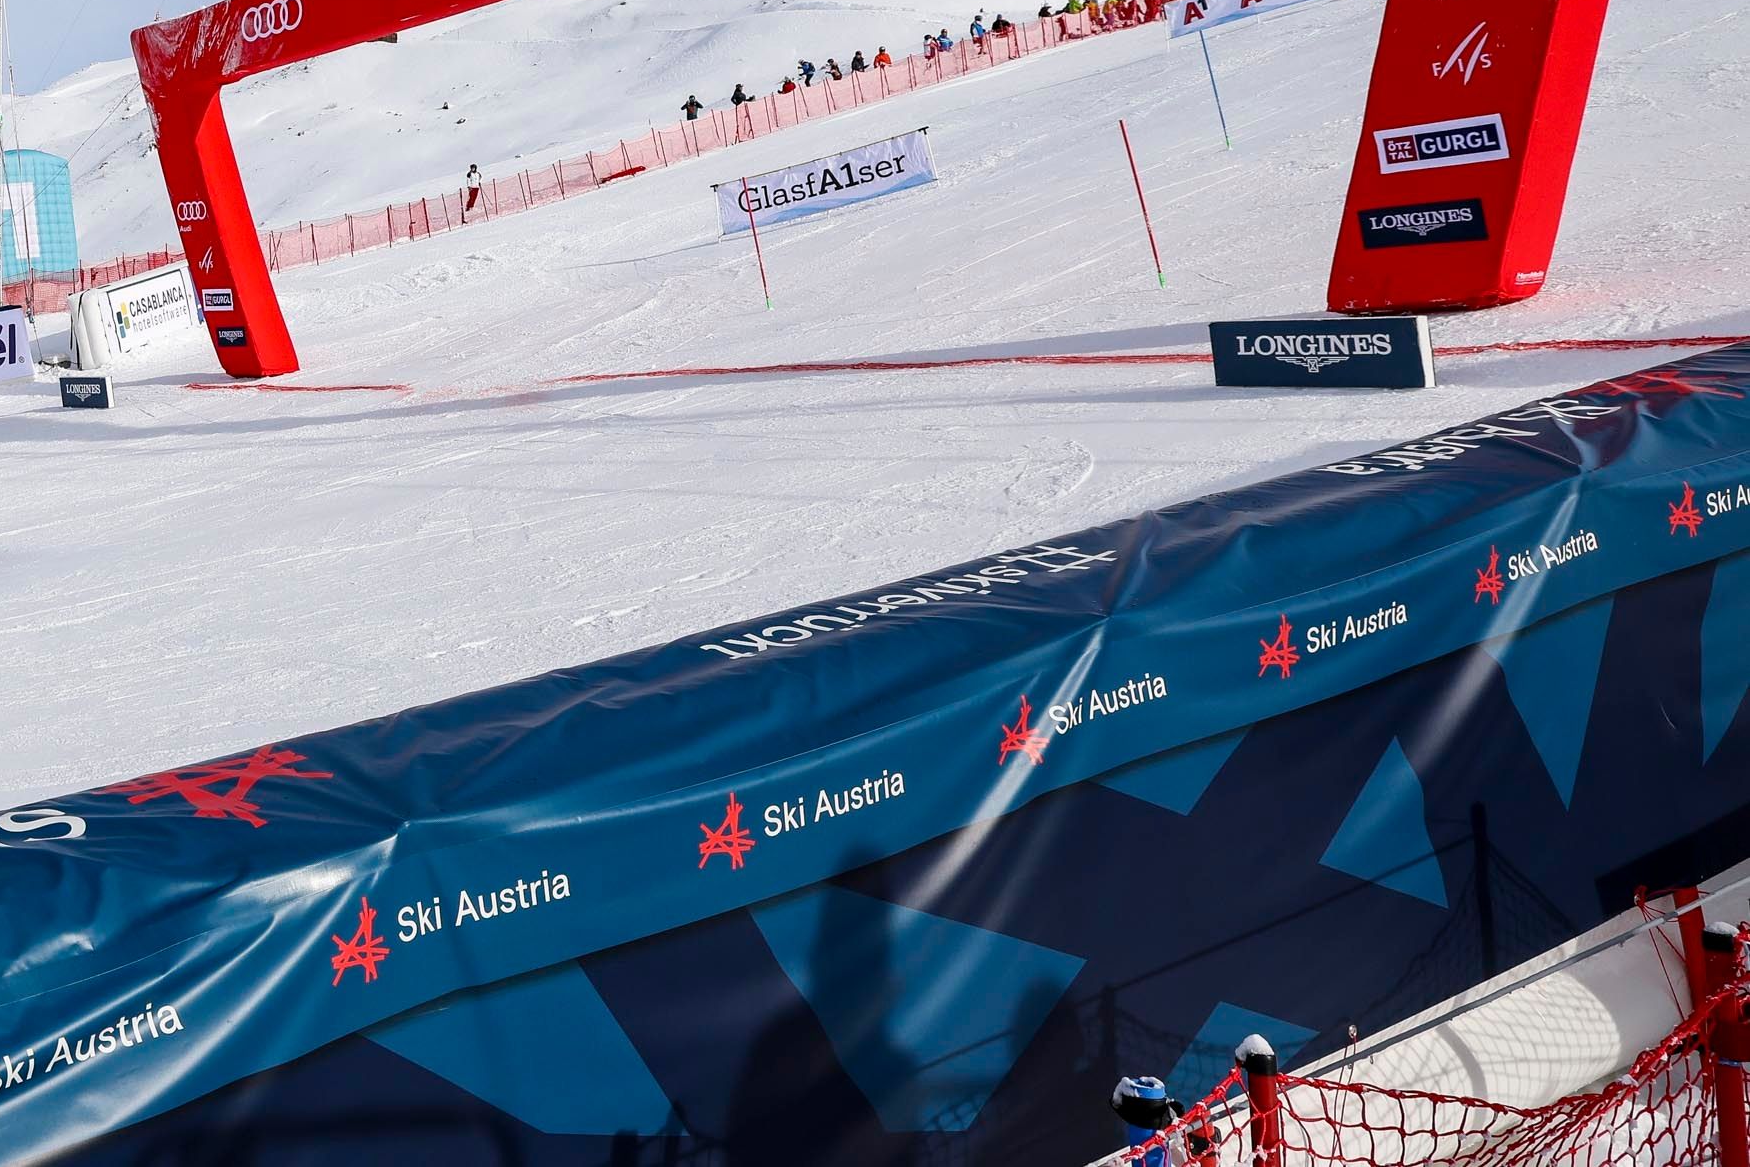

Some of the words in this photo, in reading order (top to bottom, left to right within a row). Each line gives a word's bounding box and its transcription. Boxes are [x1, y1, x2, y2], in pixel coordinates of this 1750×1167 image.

[1432, 52, 1492, 77] FIS
[1387, 140, 1412, 151] ÖTZ
[1389, 151, 1413, 160] TAL
[1420, 129, 1497, 154] GURGL
[738, 154, 906, 213] GlasfA1ser
[1370, 208, 1473, 230] LONGINES
[130, 285, 184, 317] CASABLANCA
[132, 305, 187, 333] hotelsoftware
[1237, 334, 1392, 357] LONGINES
[65, 383, 101, 395] LONGINES
[1706, 488, 1732, 516] Ski
[1508, 548, 1539, 582] Ski
[1543, 529, 1598, 571] Austria
[1306, 620, 1337, 654] Ski
[1342, 601, 1408, 642] Austria
[1049, 696, 1083, 735] Ski
[1089, 673, 1168, 722] Austria
[763, 793, 807, 837] Ski
[814, 769, 906, 822] Austria
[397, 898, 442, 943] Ski
[455, 869, 571, 928] Austria
[45, 1000, 184, 1074] Austria
